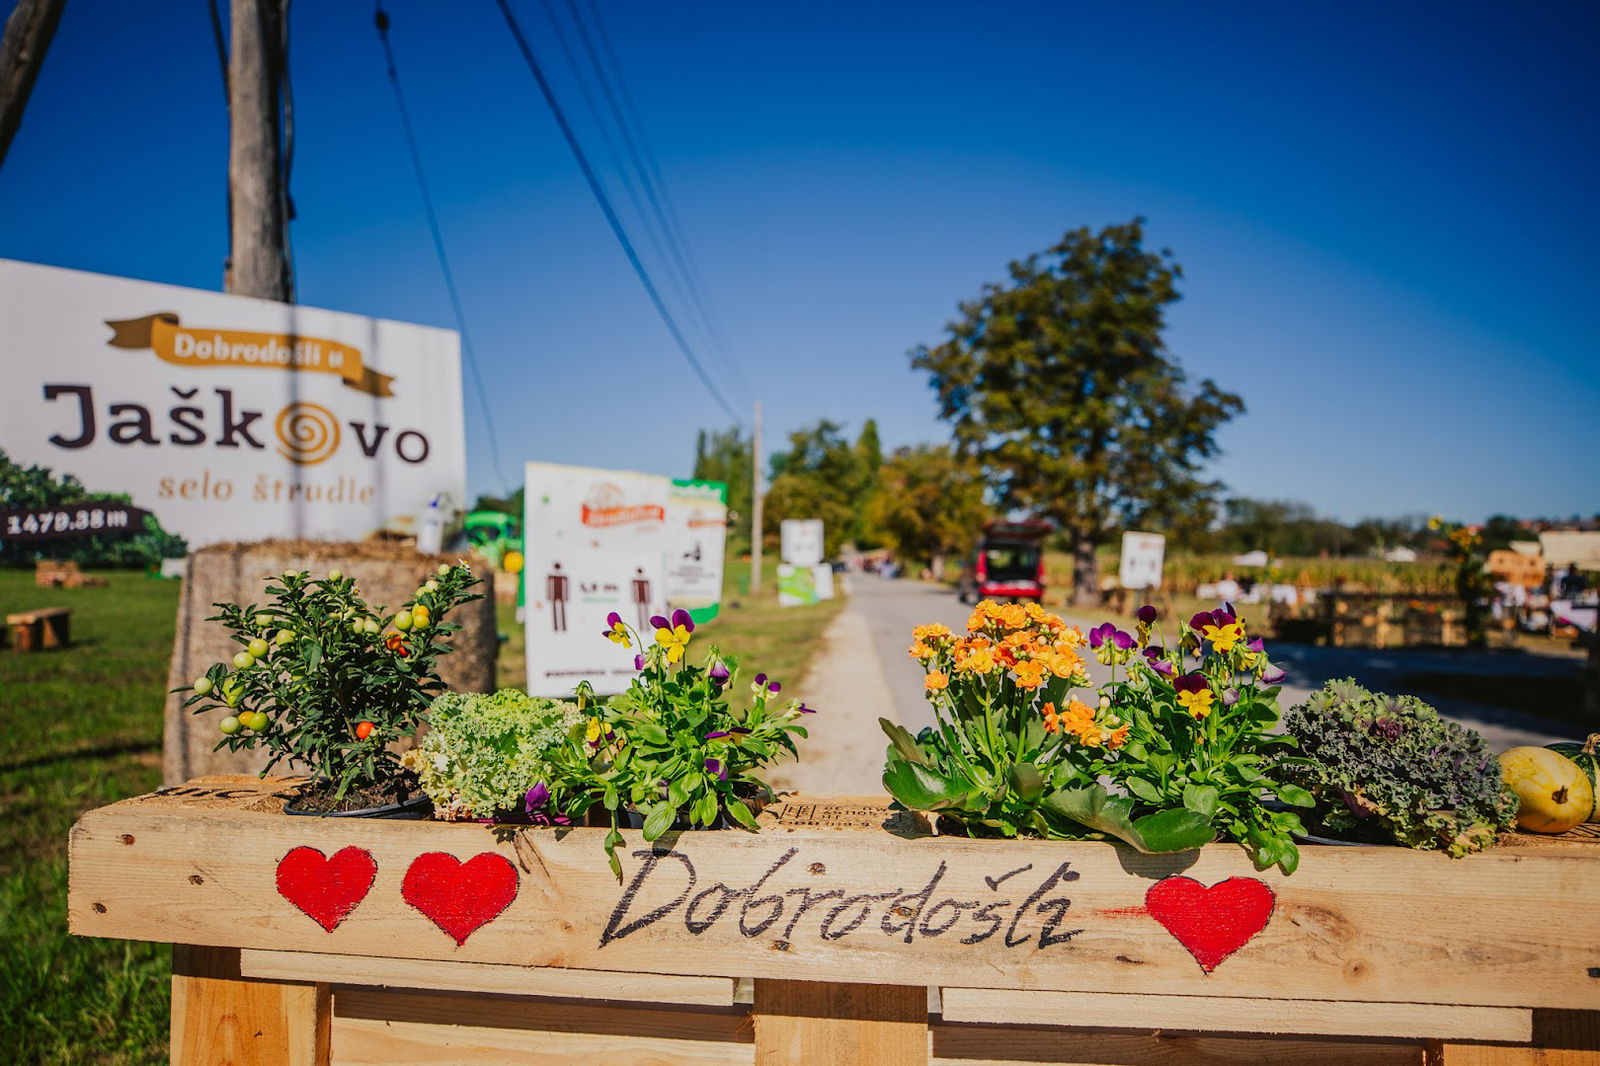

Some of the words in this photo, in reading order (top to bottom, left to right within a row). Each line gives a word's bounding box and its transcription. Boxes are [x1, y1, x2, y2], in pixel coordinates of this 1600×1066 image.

[174, 332, 321, 366] Dobrodošli
[158, 469, 234, 499] selo
[253, 473, 377, 504] štrudle
[598, 846, 1086, 950] Dobrodošli
